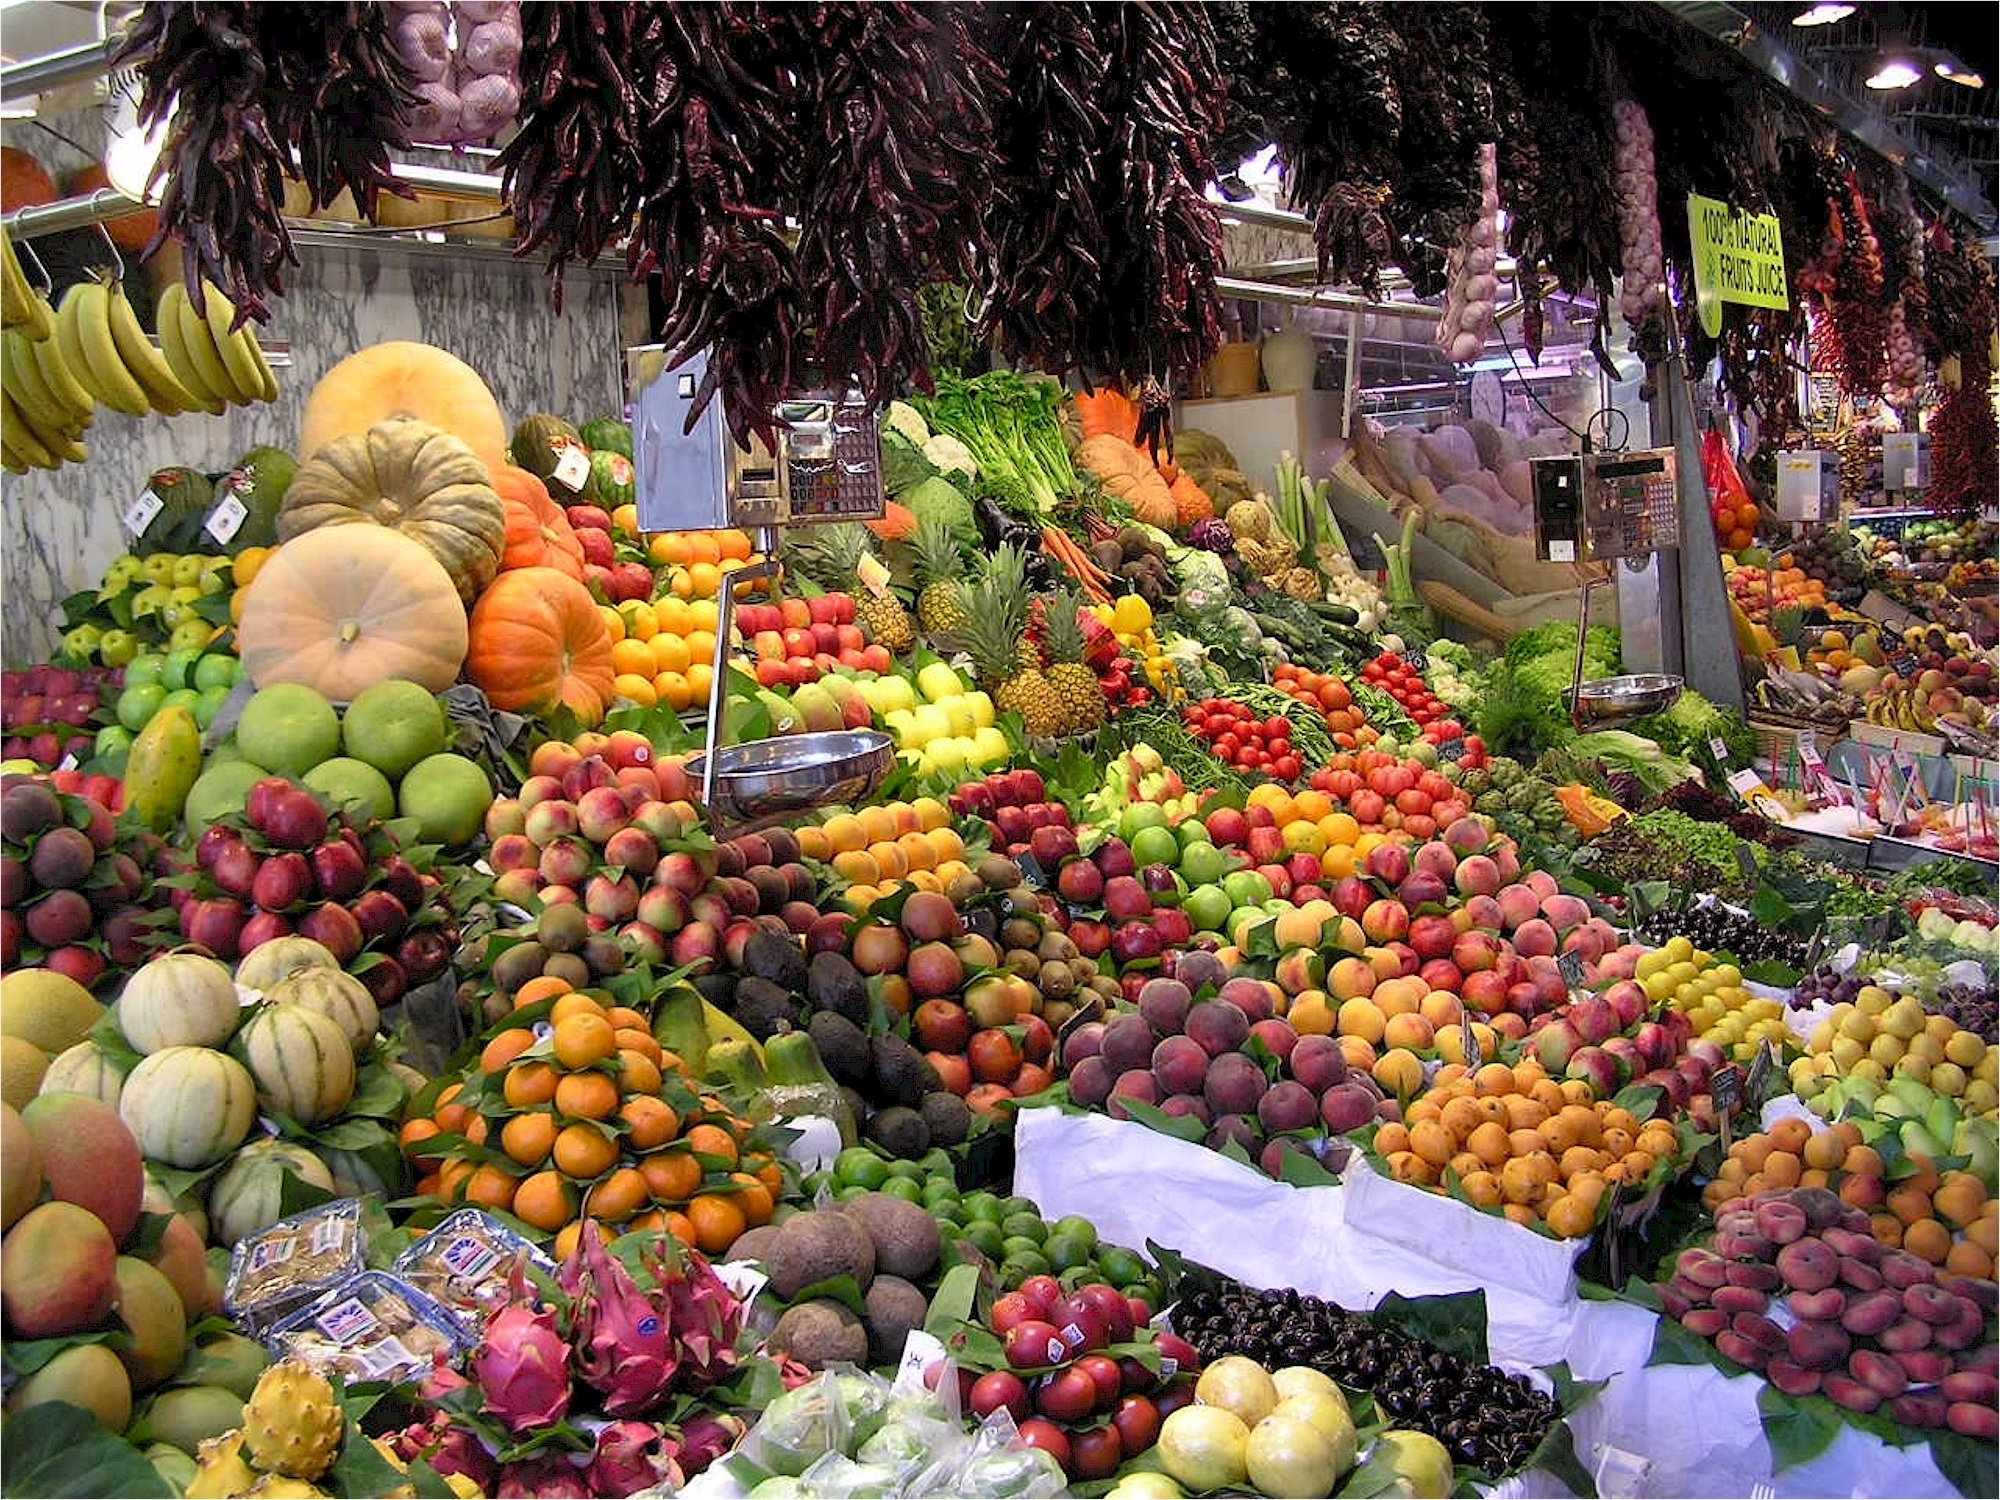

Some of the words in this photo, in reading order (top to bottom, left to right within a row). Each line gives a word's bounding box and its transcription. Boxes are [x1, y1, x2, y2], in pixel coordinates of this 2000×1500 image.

[1735, 213, 1779, 257] NATURAL
[1720, 253, 1753, 293] FRUITS
[1756, 261, 1784, 296] JUICE
